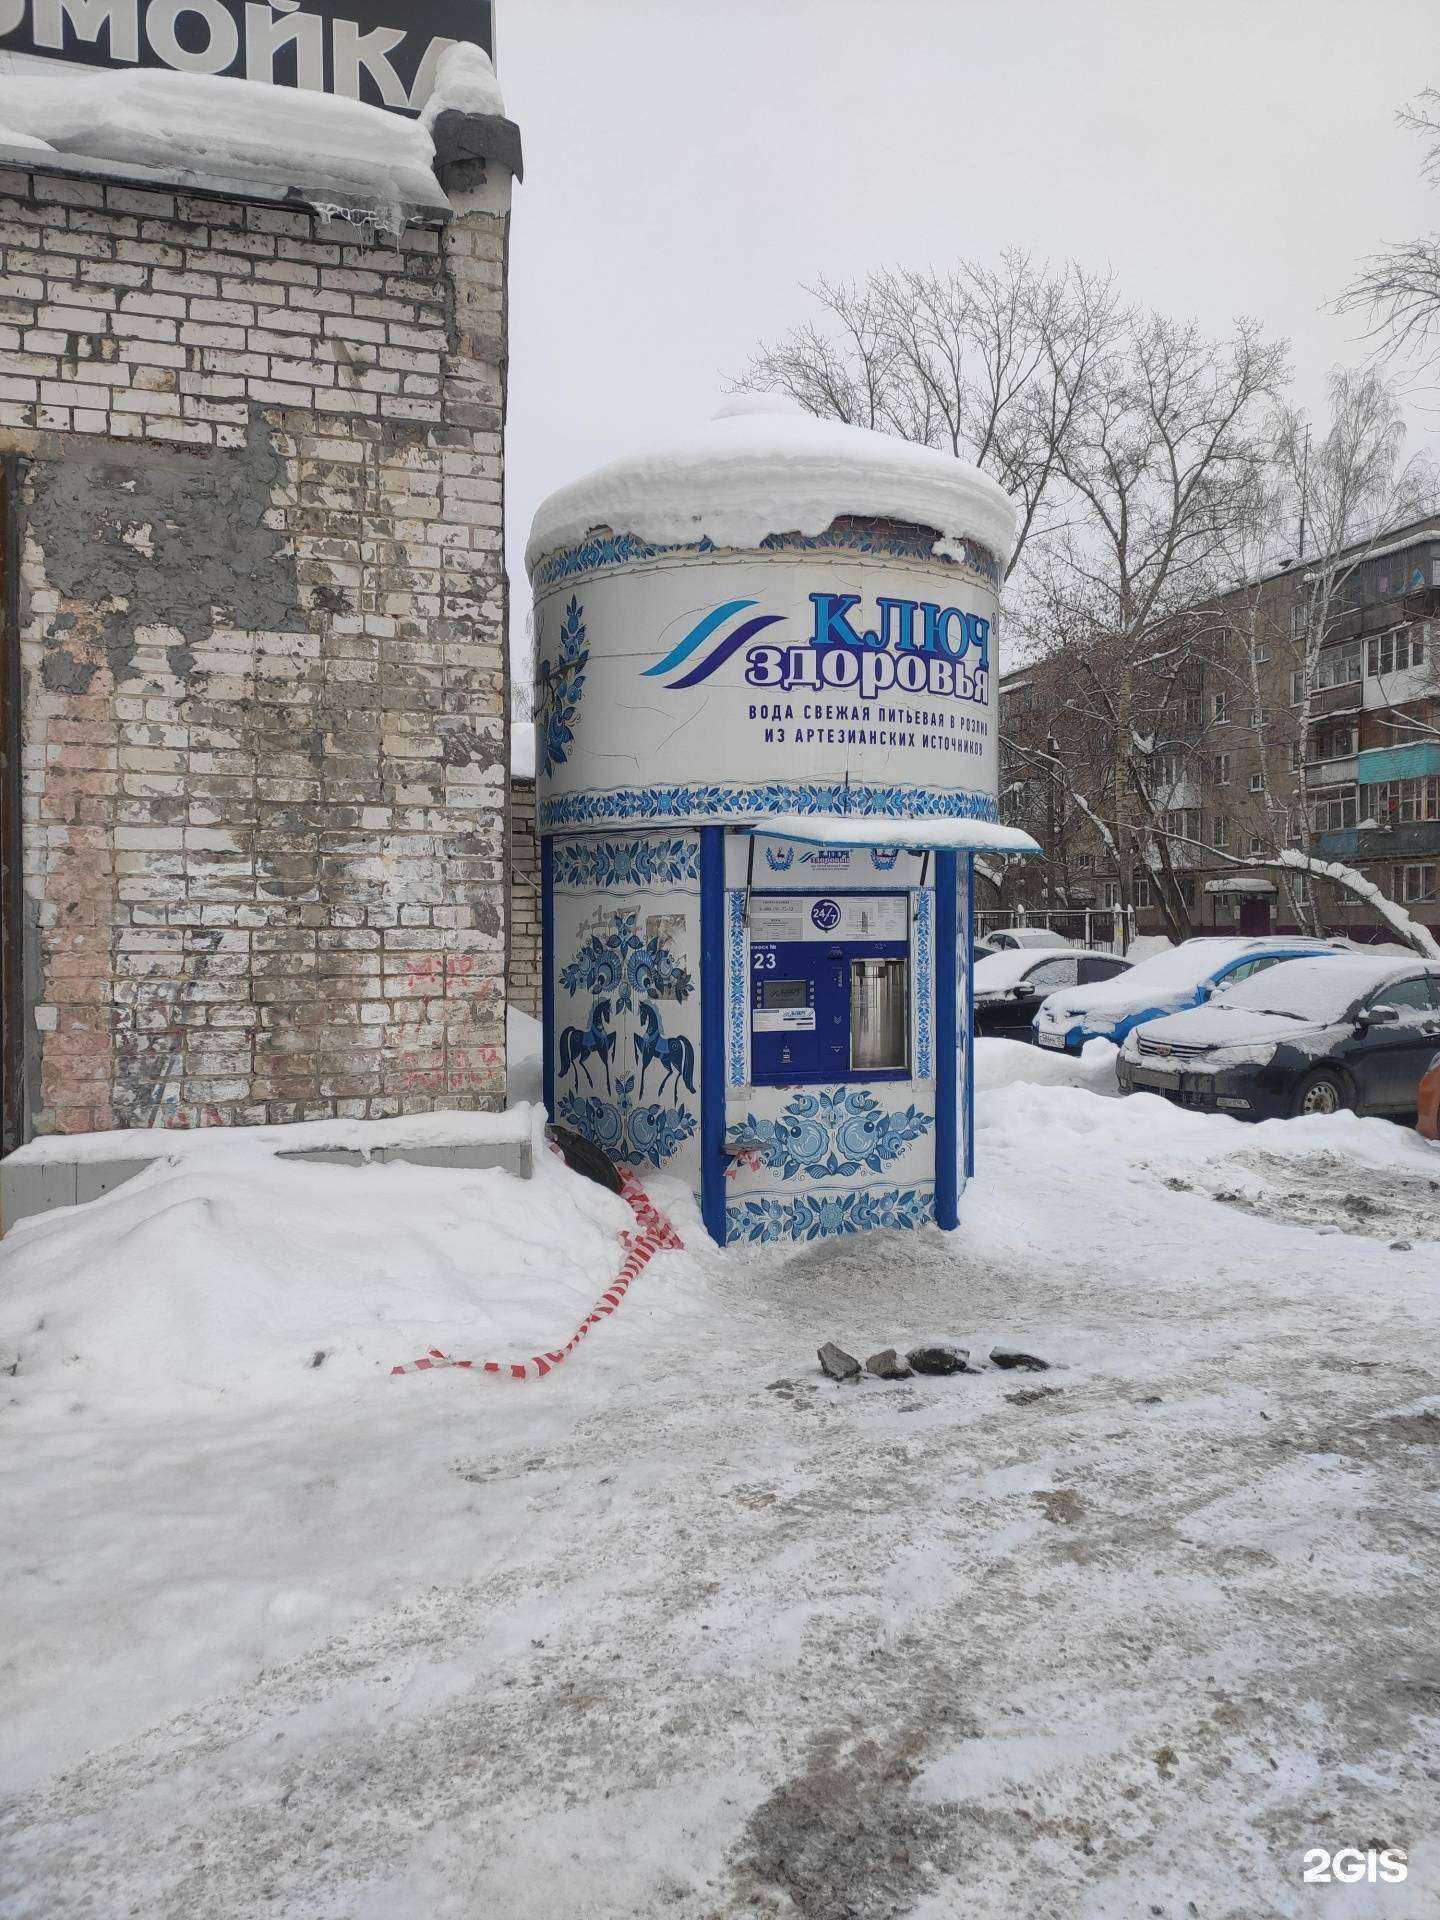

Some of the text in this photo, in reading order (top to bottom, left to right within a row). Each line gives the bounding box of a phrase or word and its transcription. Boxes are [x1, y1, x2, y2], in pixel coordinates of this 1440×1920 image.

[749, 704, 988, 736] ВОДА СВЕЖАЯ ПИТЬЕВАЯ В РОЗЛИВ
[764, 728, 984, 757] ИЗ АРТЕЗИАНСКИХ ИСТОЧНИКОВ
[813, 907, 837, 924] 24/7
[754, 953, 777, 970] 23
